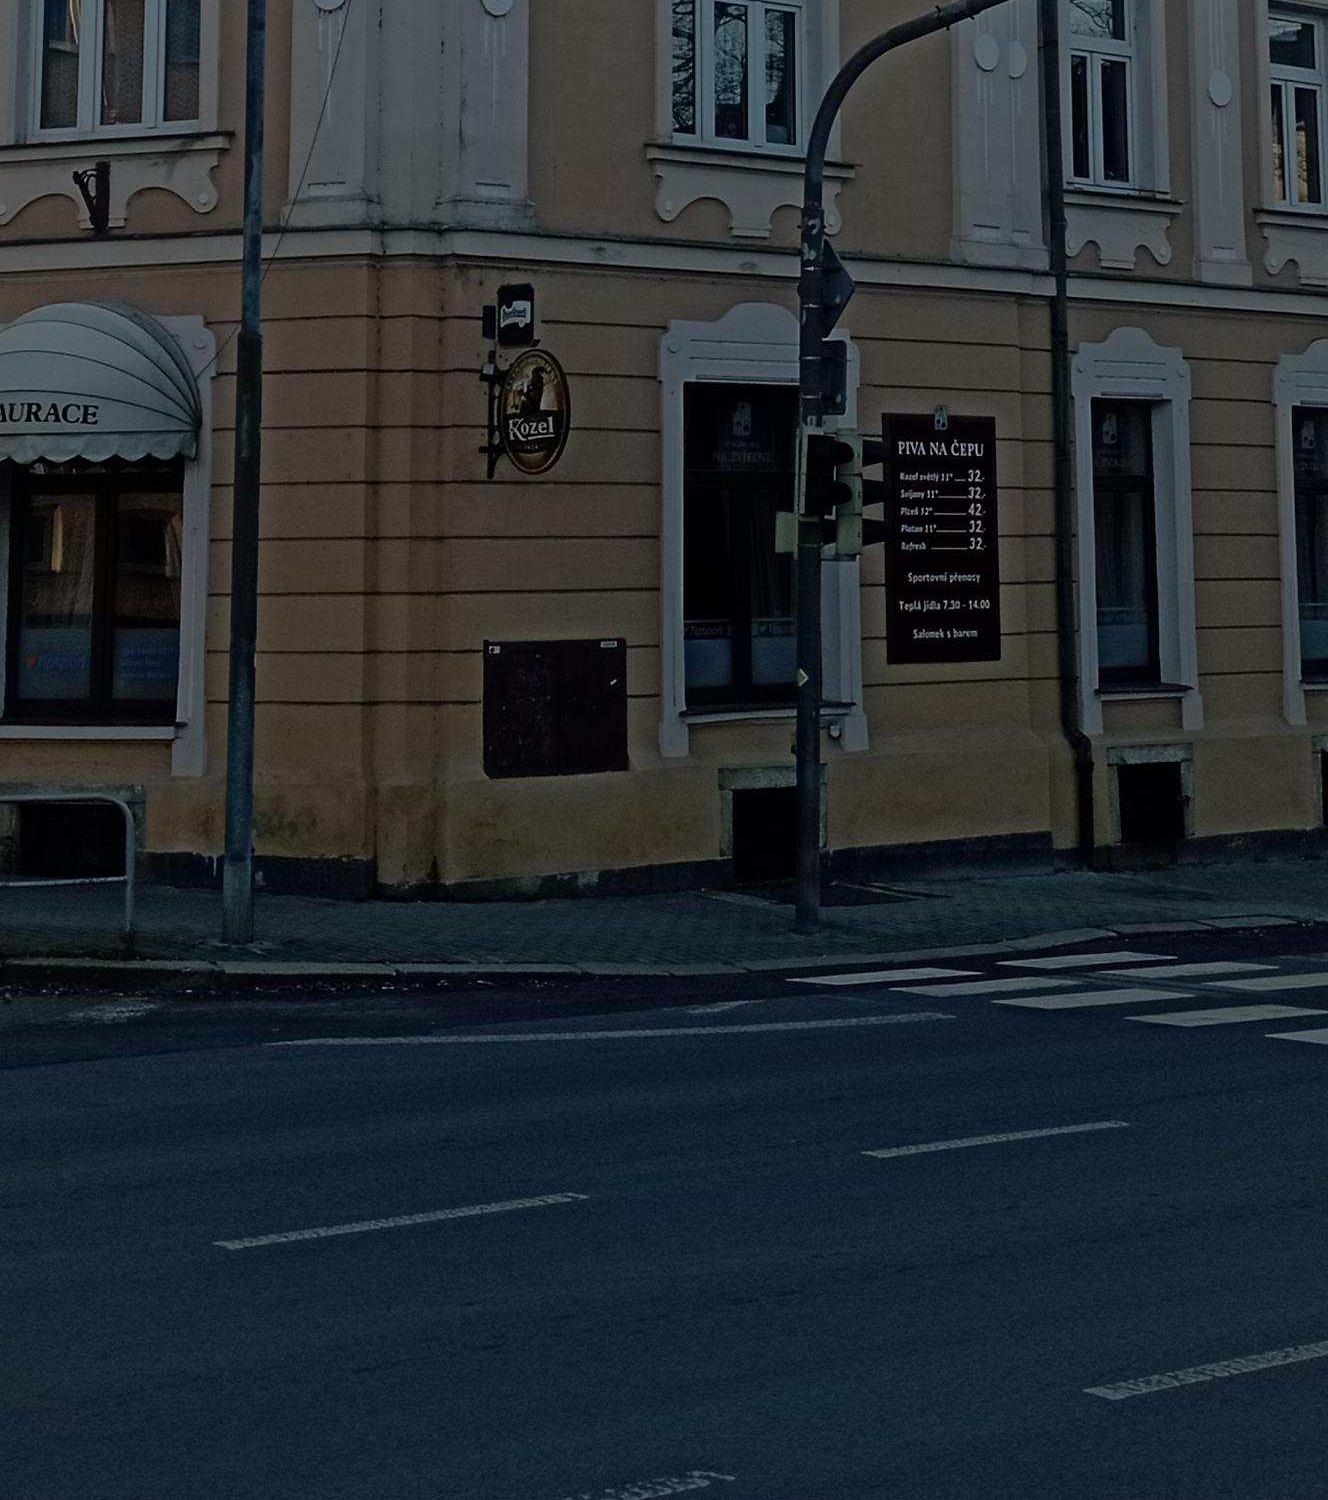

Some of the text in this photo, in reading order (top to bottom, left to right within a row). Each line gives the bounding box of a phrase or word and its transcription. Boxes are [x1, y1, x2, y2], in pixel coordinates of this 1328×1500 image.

[508, 416, 556, 442] Kozel
[897, 438, 984, 457] PIVA NA ČEPU
[908, 571, 981, 584] Sportovní přenosy
[899, 599, 922, 612] Teplá
[922, 599, 941, 612] jídla
[967, 599, 991, 610] 14.00
[952, 627, 978, 639] barem
